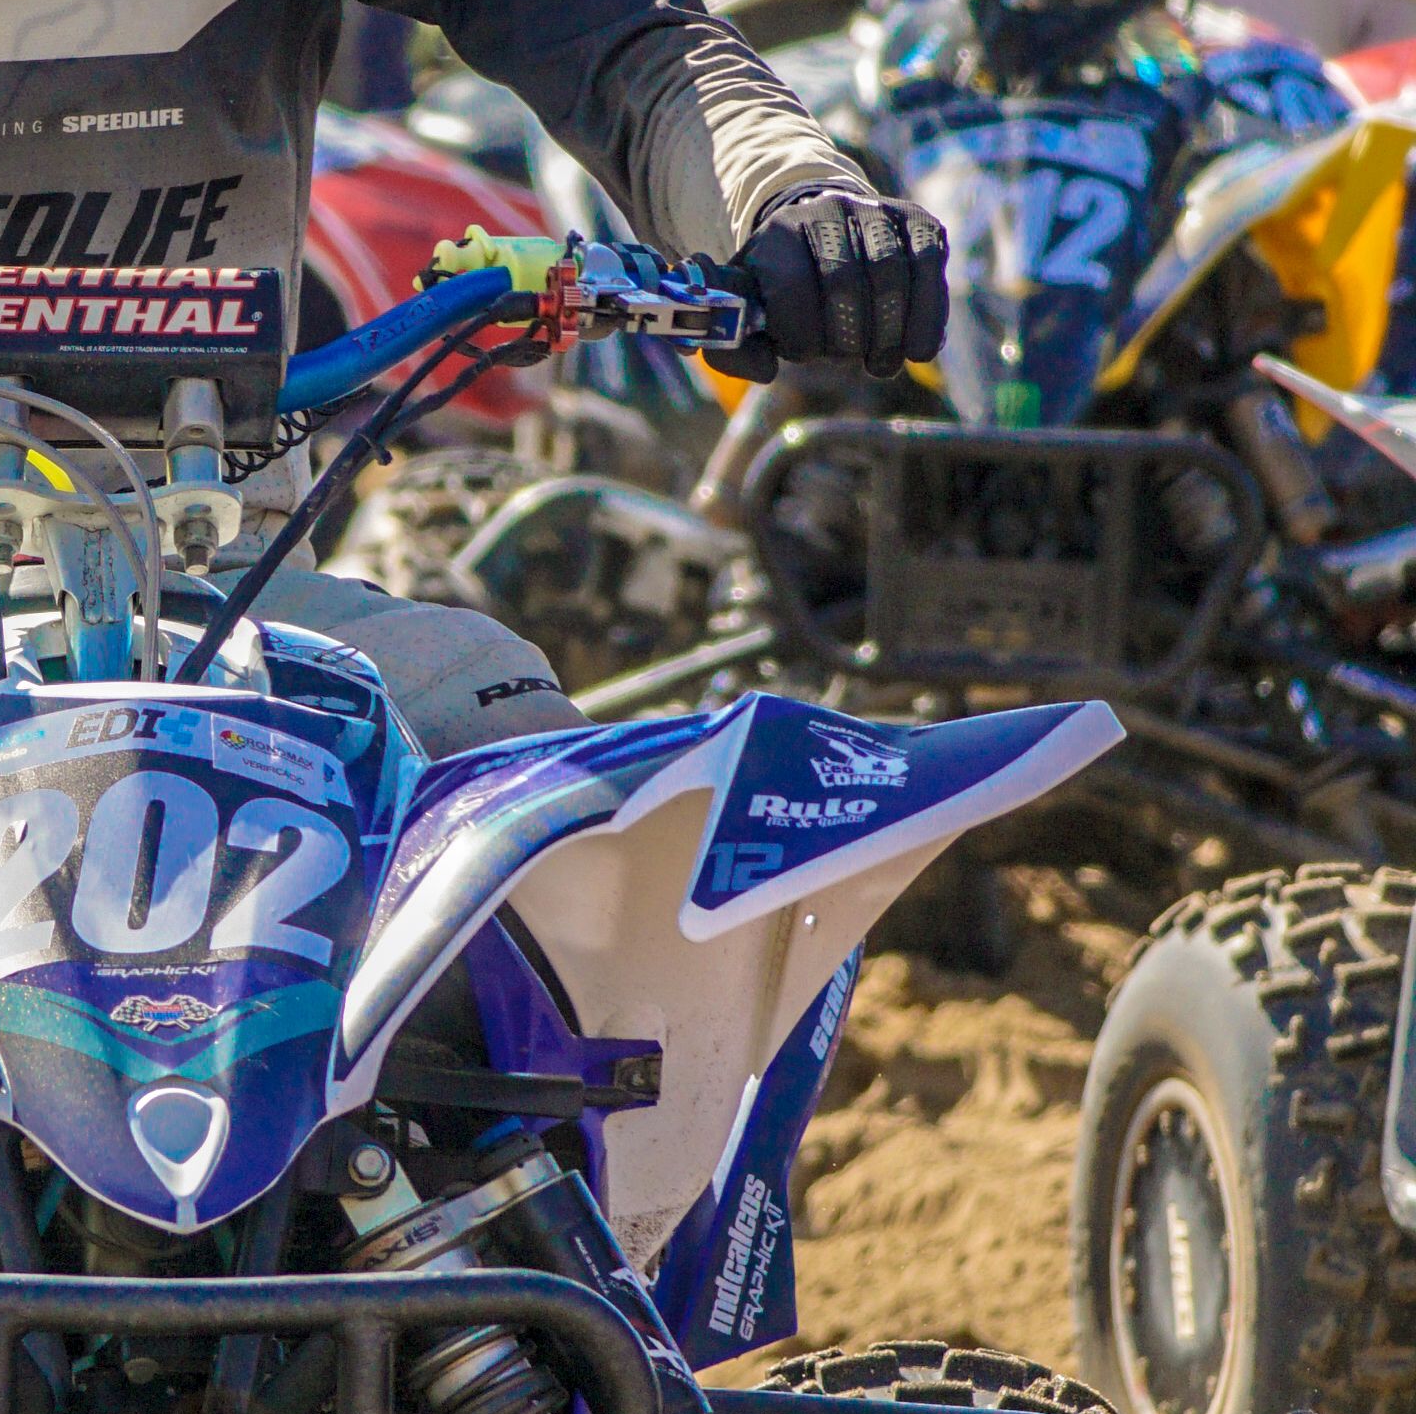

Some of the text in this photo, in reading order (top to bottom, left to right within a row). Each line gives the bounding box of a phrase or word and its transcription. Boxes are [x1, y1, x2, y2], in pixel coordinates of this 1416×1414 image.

[61, 107, 184, 135] SPEEDLIFE
[65, 707, 166, 749] EDI
[241, 756, 305, 786] VERIFICADO
[818, 772, 908, 788] CONDE
[747, 794, 878, 819] Rulo
[709, 842, 785, 893] 12
[96, 965, 190, 979] GRAPHIC
[739, 1188, 786, 1342] GRAPHIC KIT
